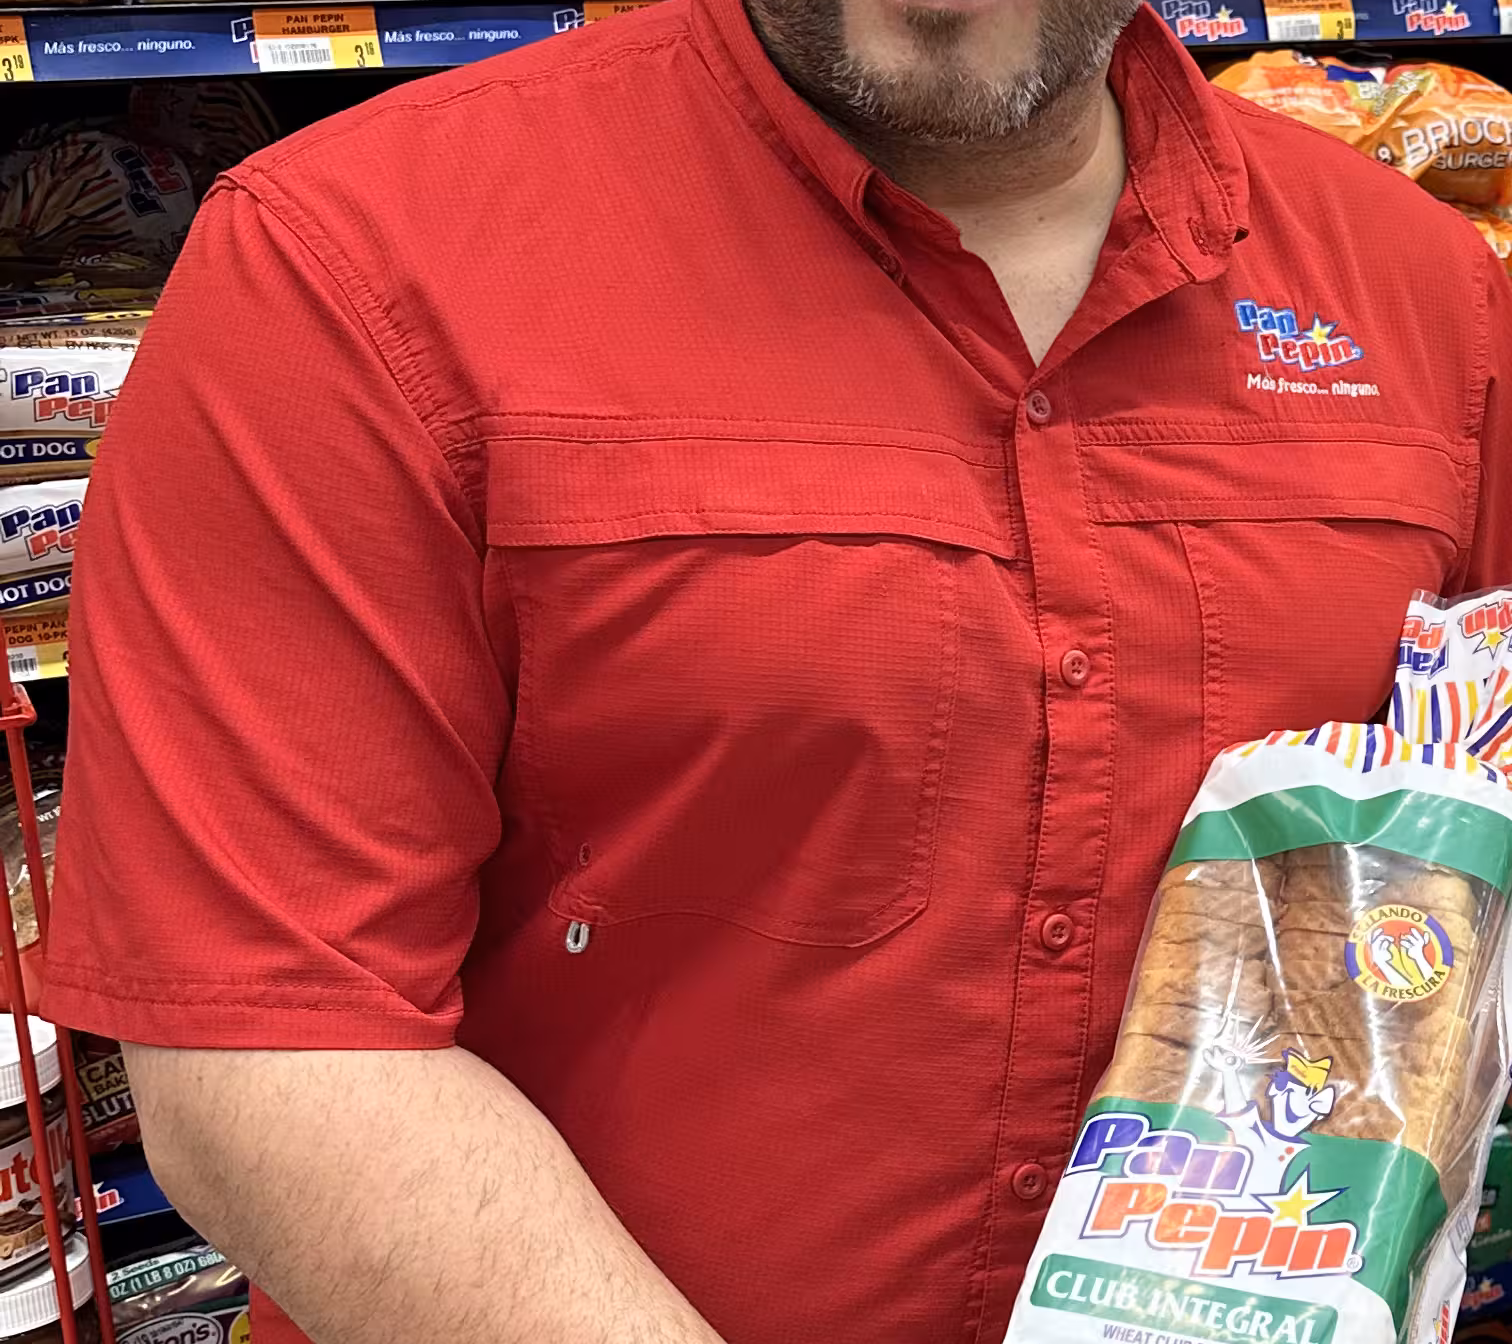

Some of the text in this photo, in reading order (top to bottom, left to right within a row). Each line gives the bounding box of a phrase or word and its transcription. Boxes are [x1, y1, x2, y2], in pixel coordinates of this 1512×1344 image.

[281, 23, 351, 35] HAMBURGER
[286, 13, 345, 24] PAN PEPIN
[44, 40, 75, 56] Más
[137, 37, 196, 54] ninguno.
[1234, 299, 1300, 336] Pan
[1255, 330, 1362, 373] Pepin
[11, 367, 100, 400] Pan
[1247, 373, 1277, 391] Más
[32, 441, 76, 457] DOG
[1382, 970, 1447, 999] FRESCURA
[1066, 1113, 1254, 1196] Pan
[1081, 1177, 1364, 1280] Pepin
[1046, 1270, 1140, 1311] CLUB
